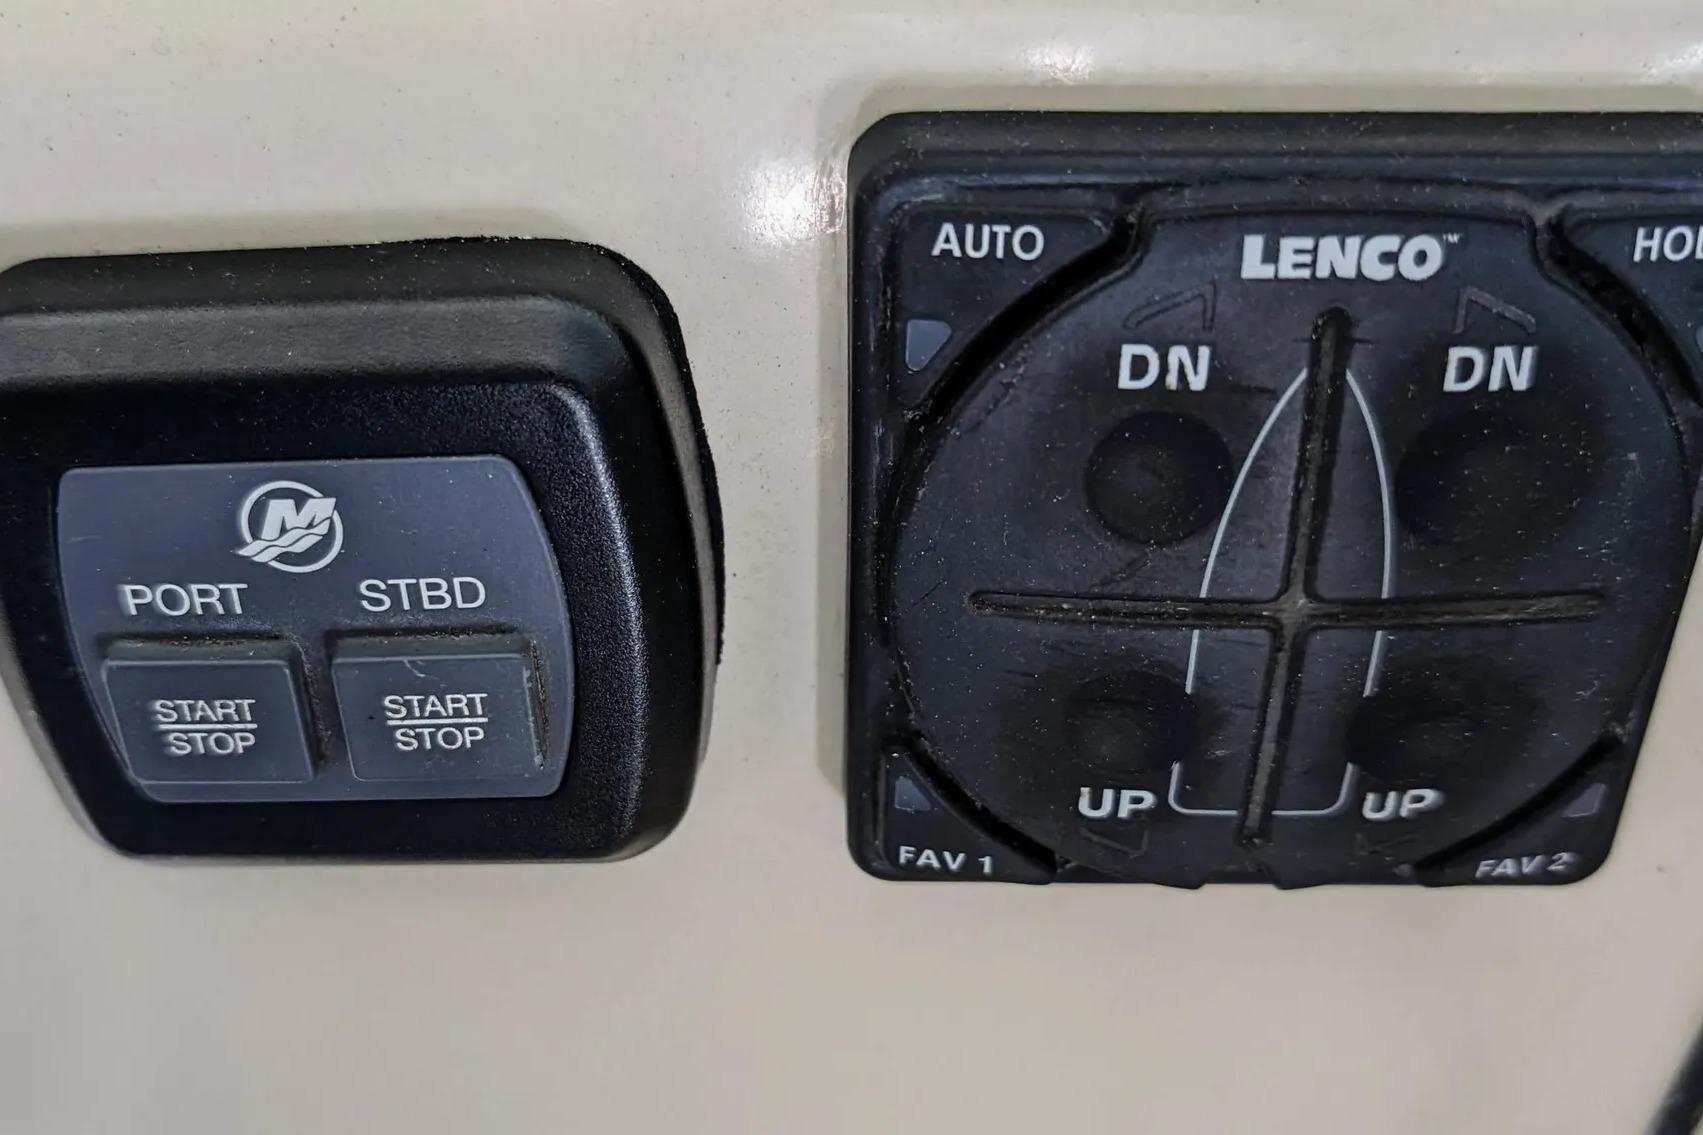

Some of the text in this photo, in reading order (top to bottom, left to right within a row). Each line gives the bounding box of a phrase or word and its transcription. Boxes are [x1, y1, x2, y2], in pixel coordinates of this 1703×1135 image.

[931, 222, 1045, 261] AUTO
[1240, 233, 1446, 282] LENCO
[1117, 343, 1213, 392] DN
[1442, 344, 1540, 393] DN
[120, 583, 249, 617] PORT
[359, 576, 487, 612] STBD
[153, 698, 256, 723] START
[383, 692, 488, 719] START
[166, 731, 256, 757] STOP
[394, 726, 485, 752] STOP
[1077, 786, 1157, 819] UP
[1361, 788, 1444, 822] UP
[898, 845, 994, 876] FAV 1
[1474, 852, 1577, 879] FAV 2
